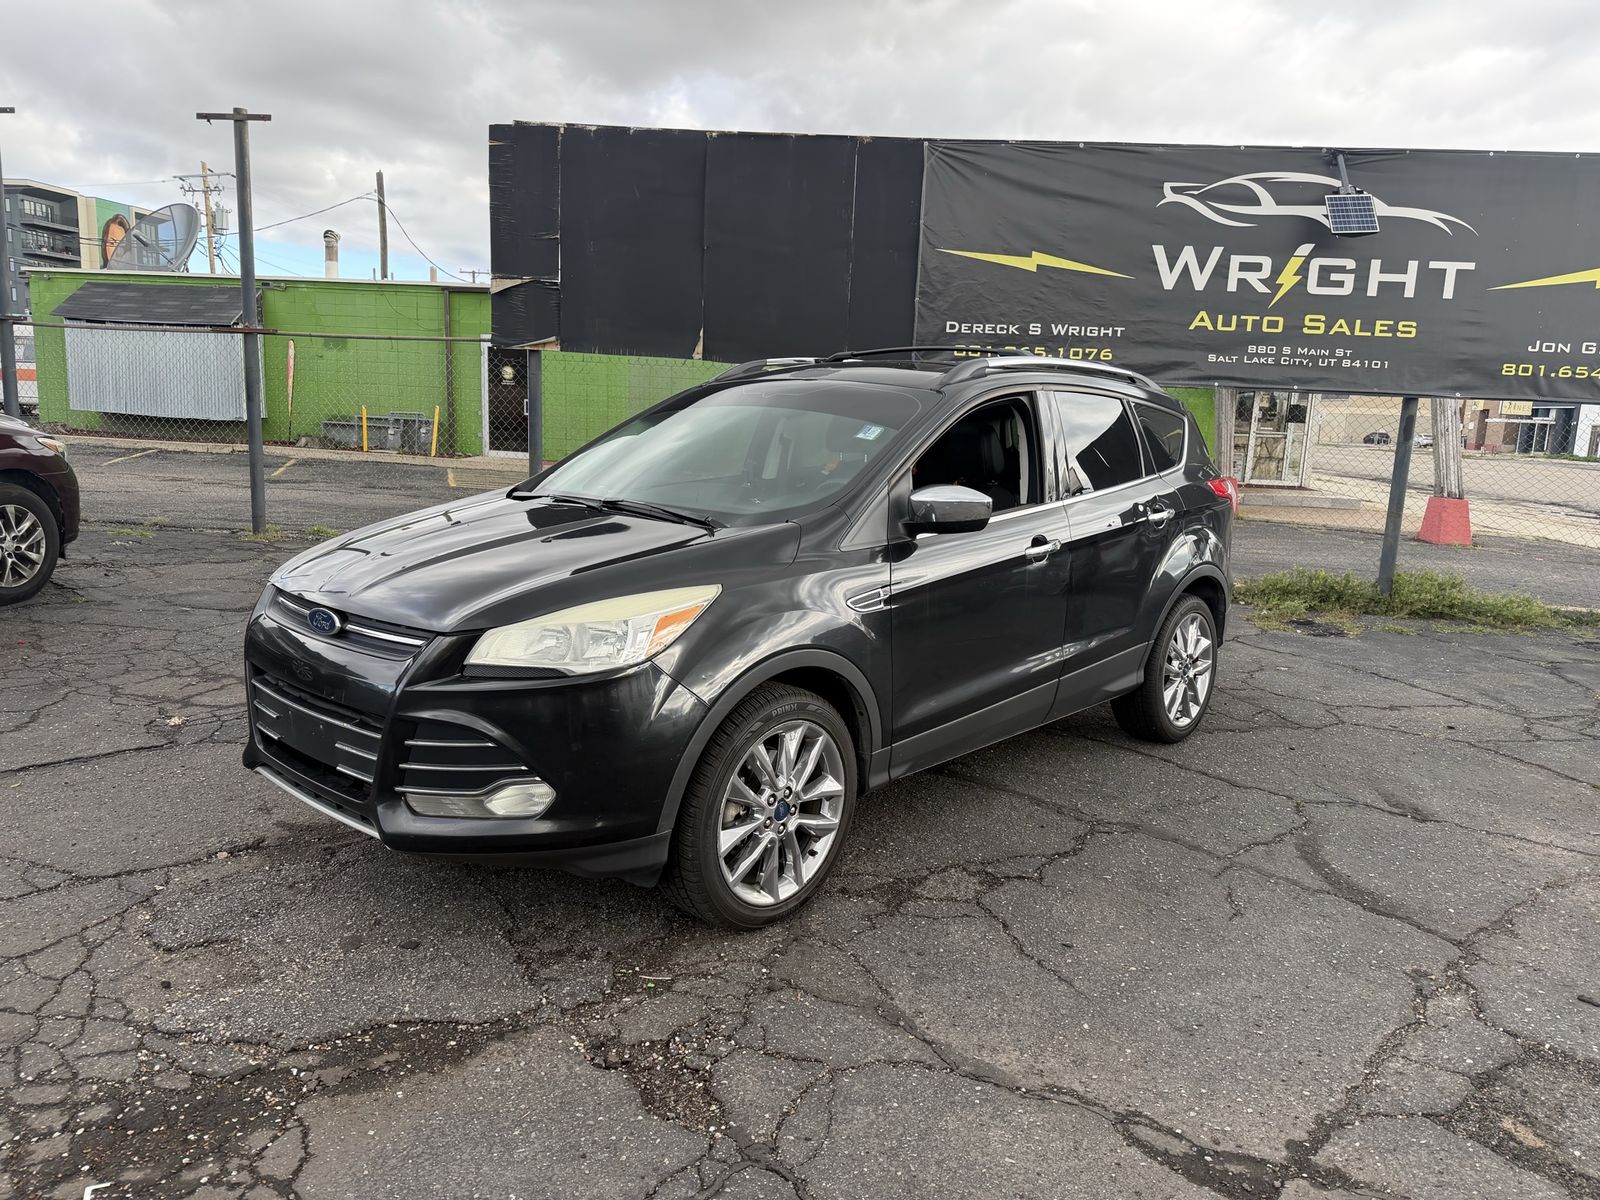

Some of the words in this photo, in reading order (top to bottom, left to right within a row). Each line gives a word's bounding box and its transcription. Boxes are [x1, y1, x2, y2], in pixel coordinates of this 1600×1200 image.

[1152, 243, 1476, 309] WRIGHT
[945, 321, 1020, 335] DERECK
[1028, 323, 1042, 335] S
[1051, 323, 1126, 337] WRIGHT
[1189, 310, 1284, 333] AUTO
[1302, 314, 1418, 338] SALES
[1247, 345, 1277, 354] 880
[1282, 346, 1291, 355] S
[1297, 347, 1329, 357] MAIN
[1335, 348, 1352, 357] ST
[1527, 340, 1571, 353] JON
[1581, 342, 1600, 355] G
[1207, 354, 1238, 363] SALT
[1243, 356, 1275, 365] LAKE
[1280, 357, 1313, 367] CITY,
[1318, 359, 1337, 367] UT
[1341, 359, 1390, 369] 84101
[312, 611, 332, 631] Ford
